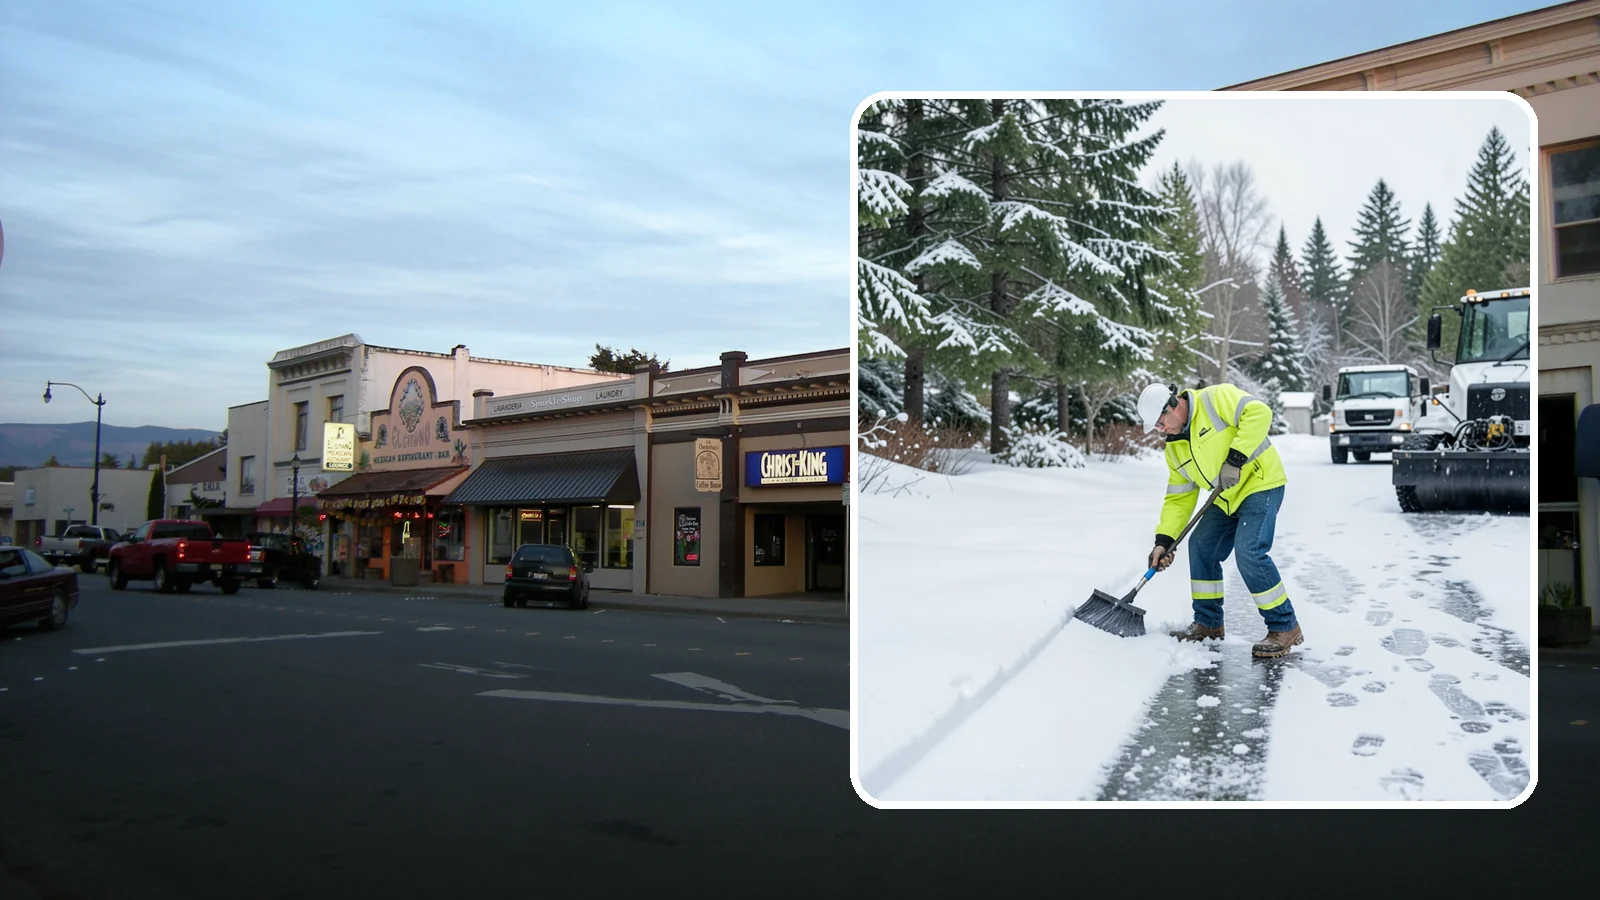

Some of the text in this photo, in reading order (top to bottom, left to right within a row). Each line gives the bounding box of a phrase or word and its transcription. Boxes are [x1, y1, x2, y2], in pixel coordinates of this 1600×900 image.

[596, 389, 624, 400] LAUNDRY
[530, 394, 582, 408] Sparkle Shop
[494, 403, 523, 412] LAVANDERIA
[374, 455, 396, 464] MEXICAN
[398, 451, 433, 462] RESTAURANT
[438, 450, 450, 458] BAR
[761, 450, 826, 478] CHRIST KING
[697, 480, 722, 488] Coffee House
